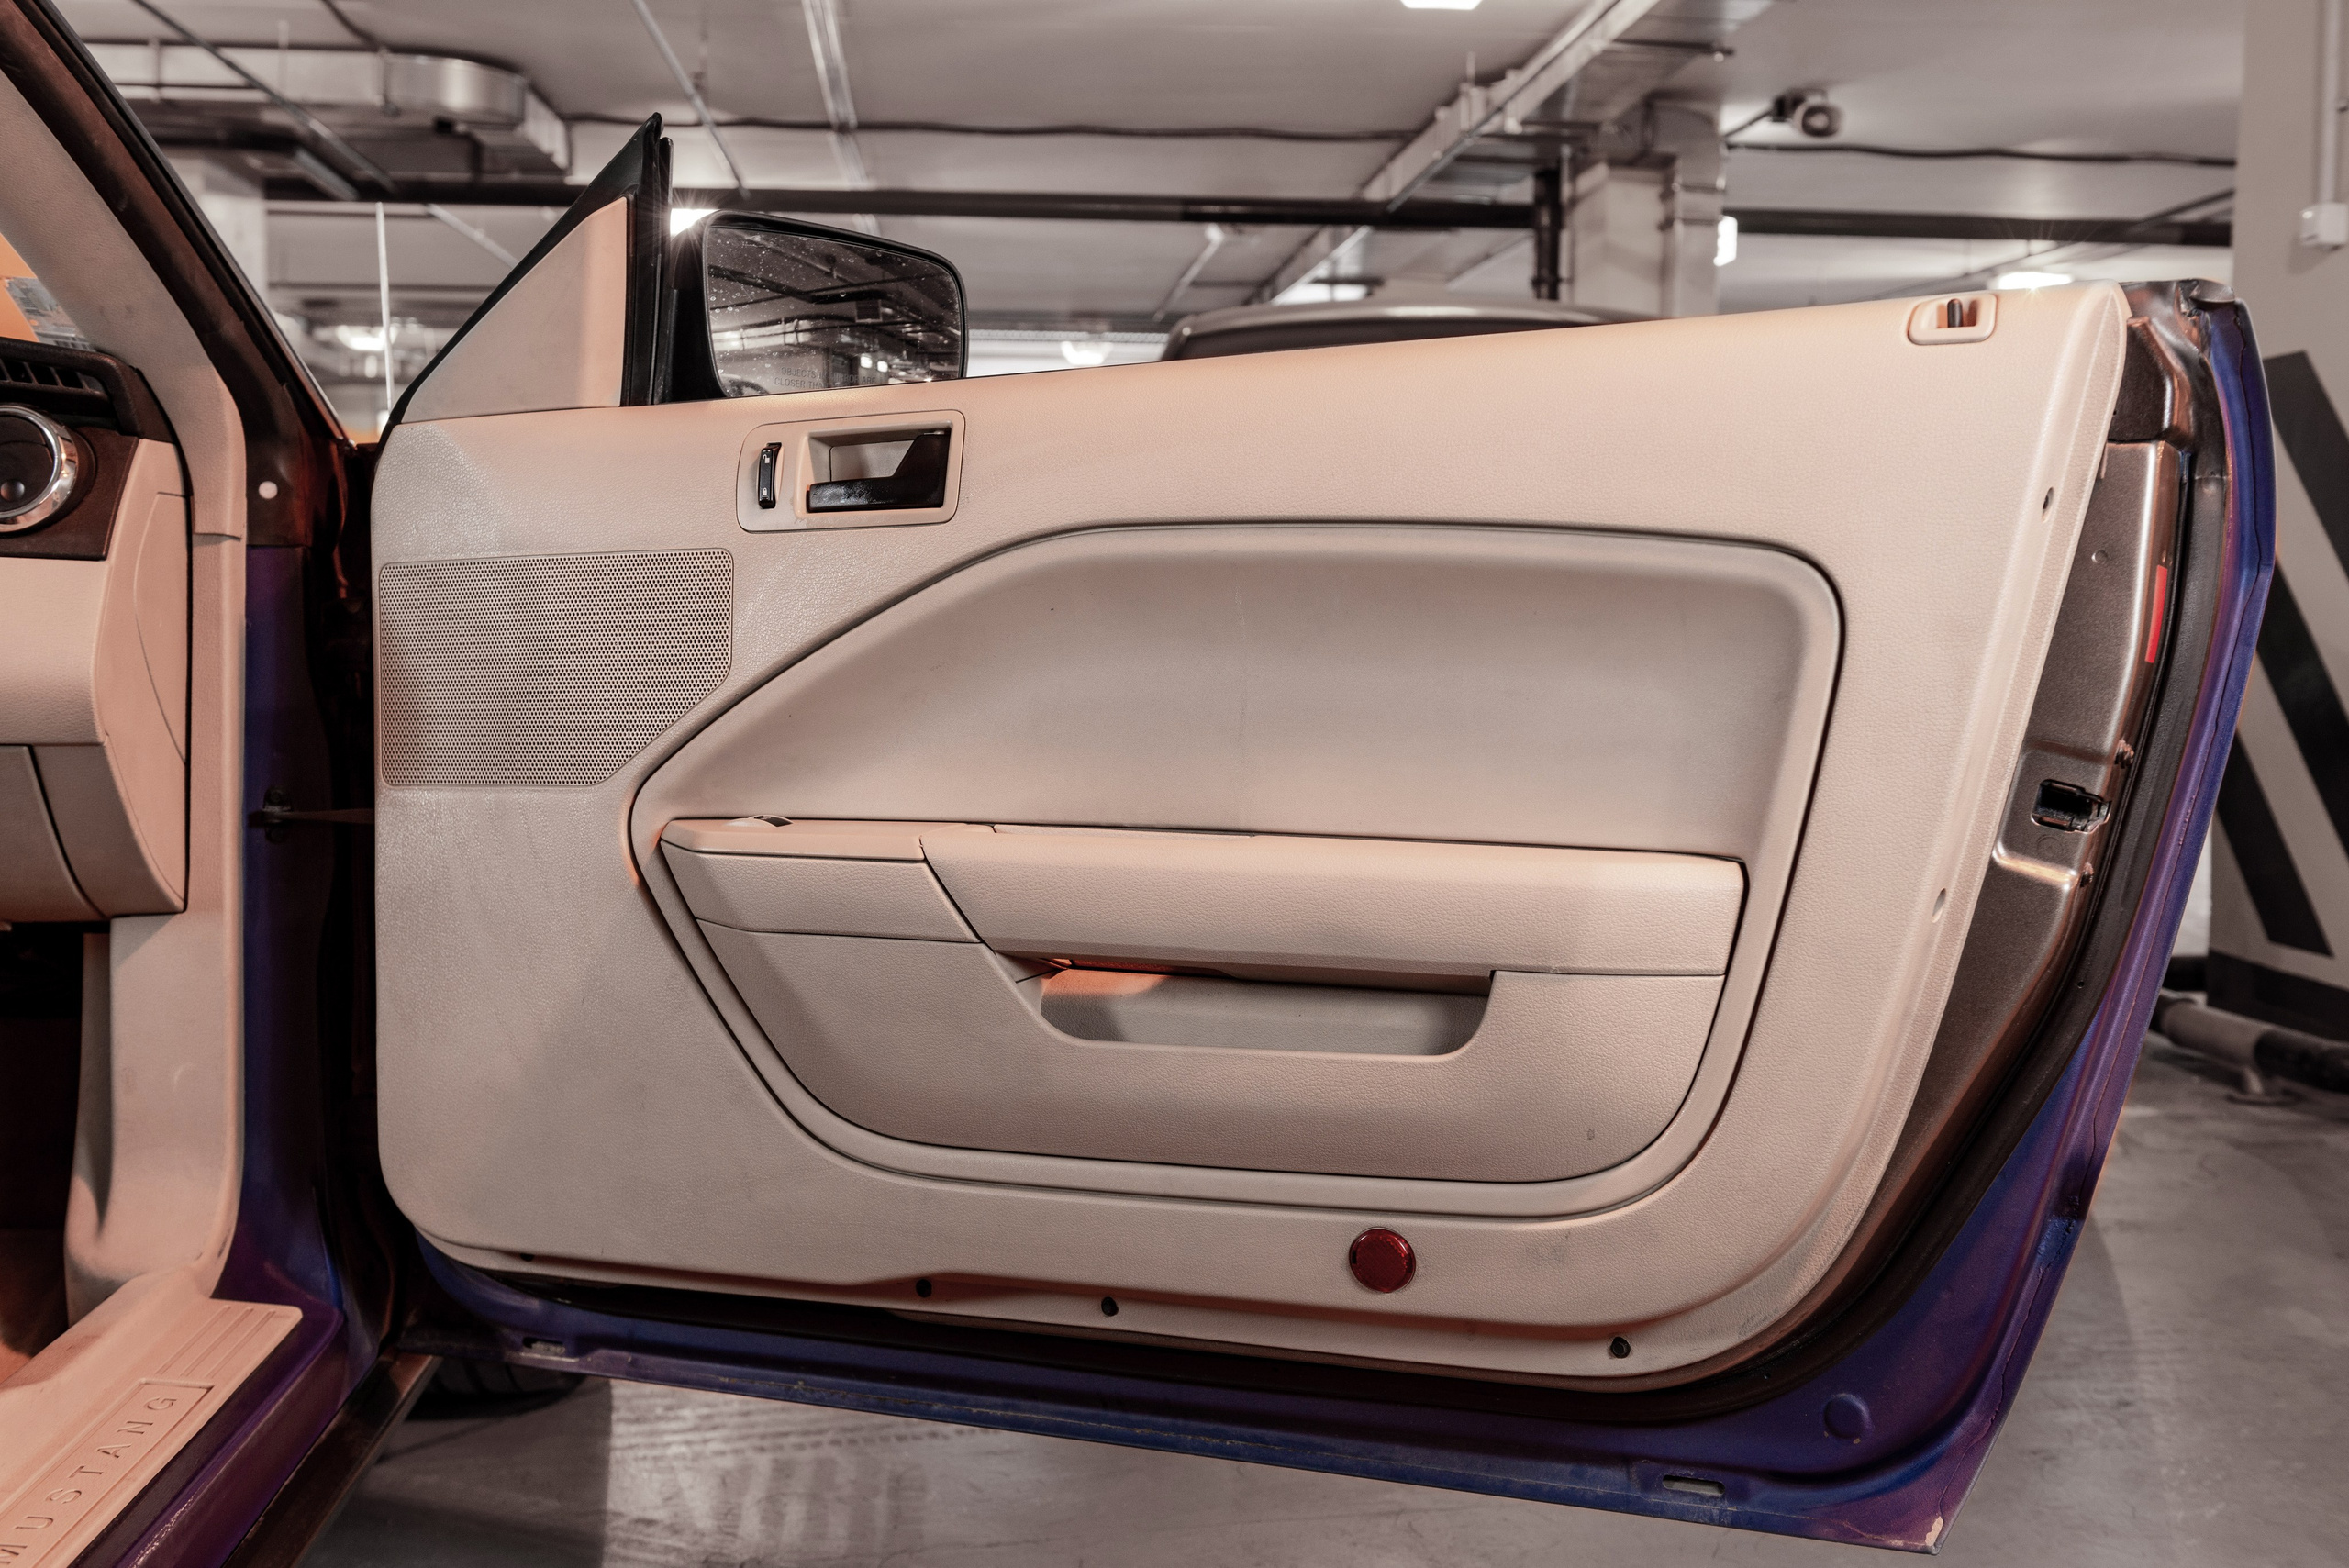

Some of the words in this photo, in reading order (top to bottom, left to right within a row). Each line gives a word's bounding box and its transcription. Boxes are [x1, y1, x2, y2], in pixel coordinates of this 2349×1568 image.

[774, 377, 806, 388] CLOSER
[781, 367, 817, 379] OBJECTS
[863, 376, 876, 384] ARE
[0, 1396, 177, 1565] MUSTANG
